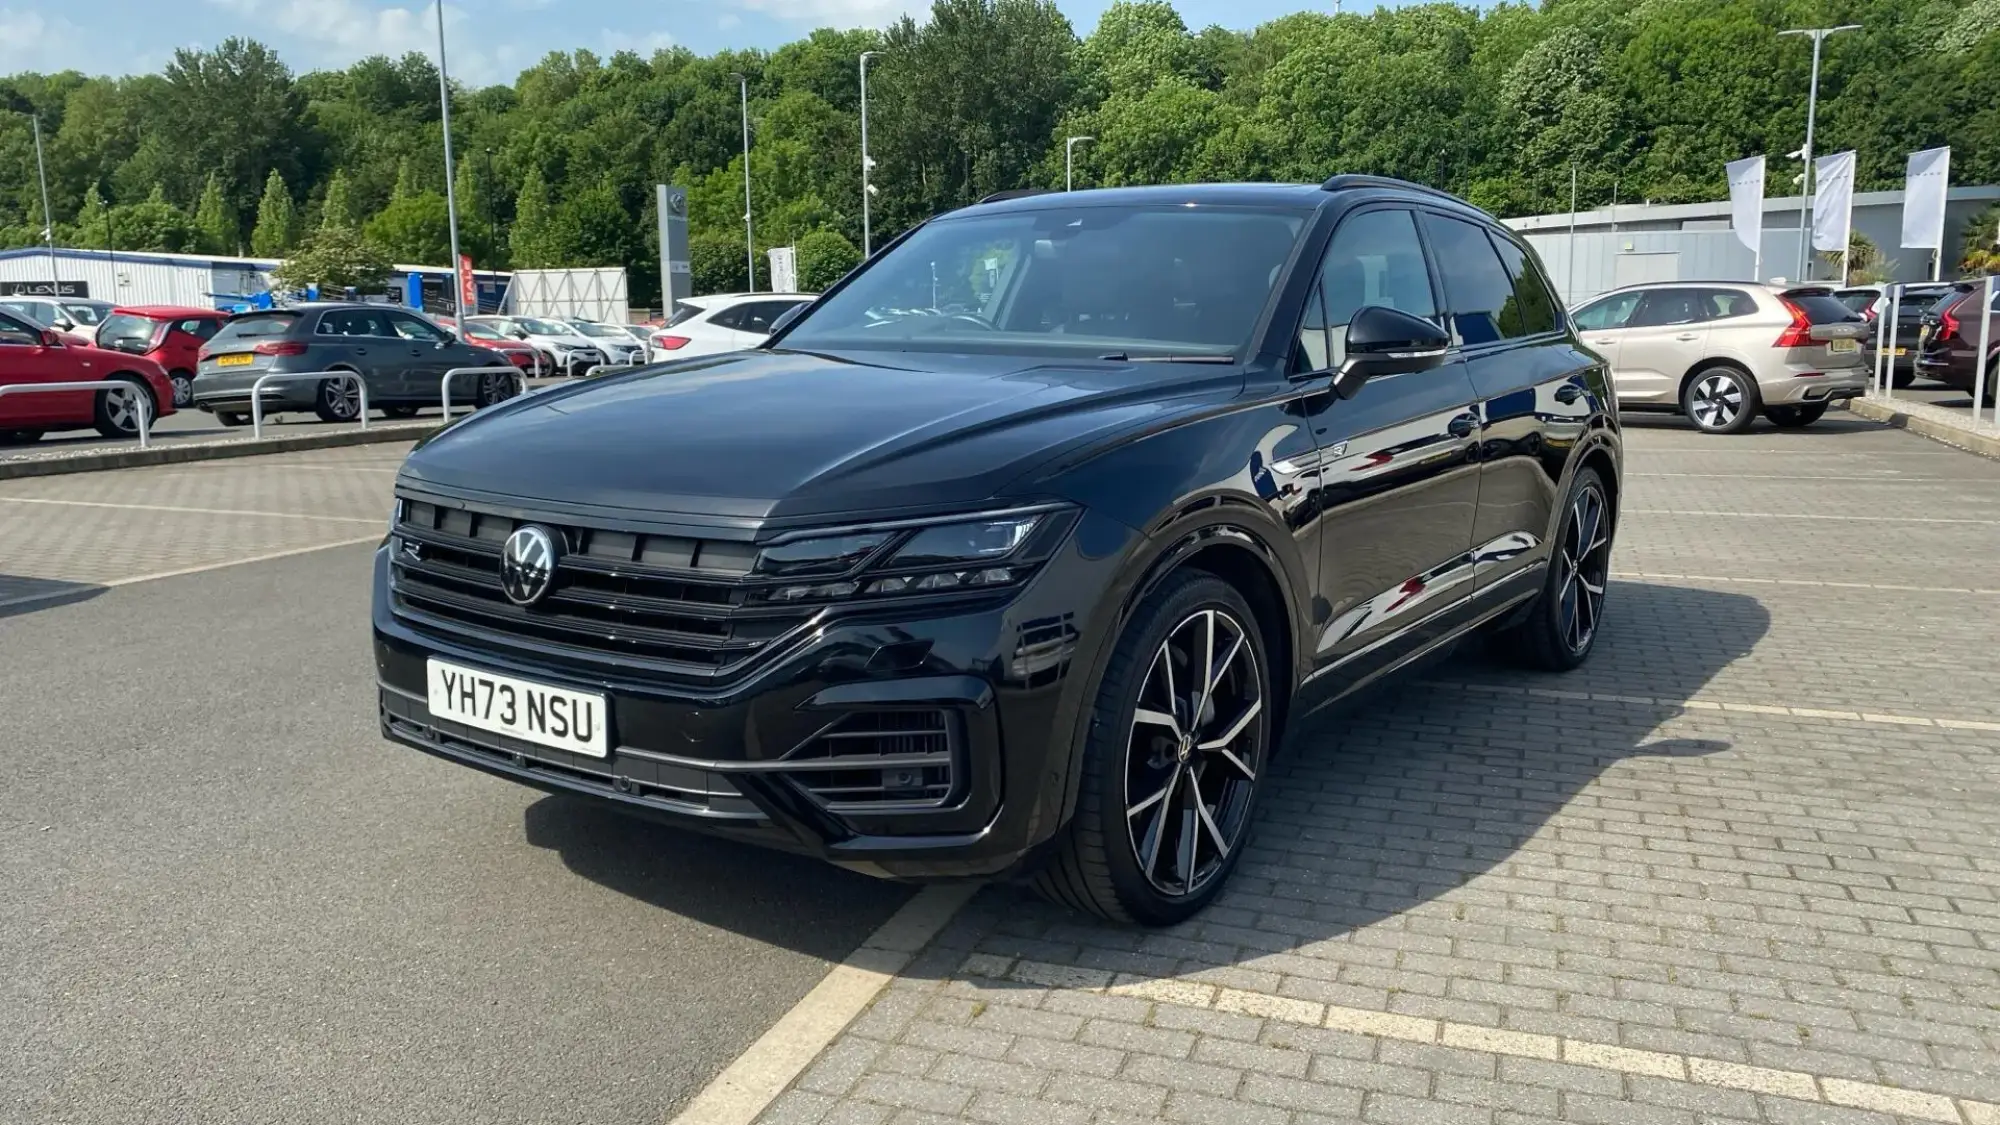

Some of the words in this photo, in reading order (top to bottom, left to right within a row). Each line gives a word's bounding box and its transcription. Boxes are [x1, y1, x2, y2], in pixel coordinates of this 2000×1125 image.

[27, 284, 75, 294] LEXUS
[441, 669, 516, 725] YH73
[527, 690, 593, 743] NSU
